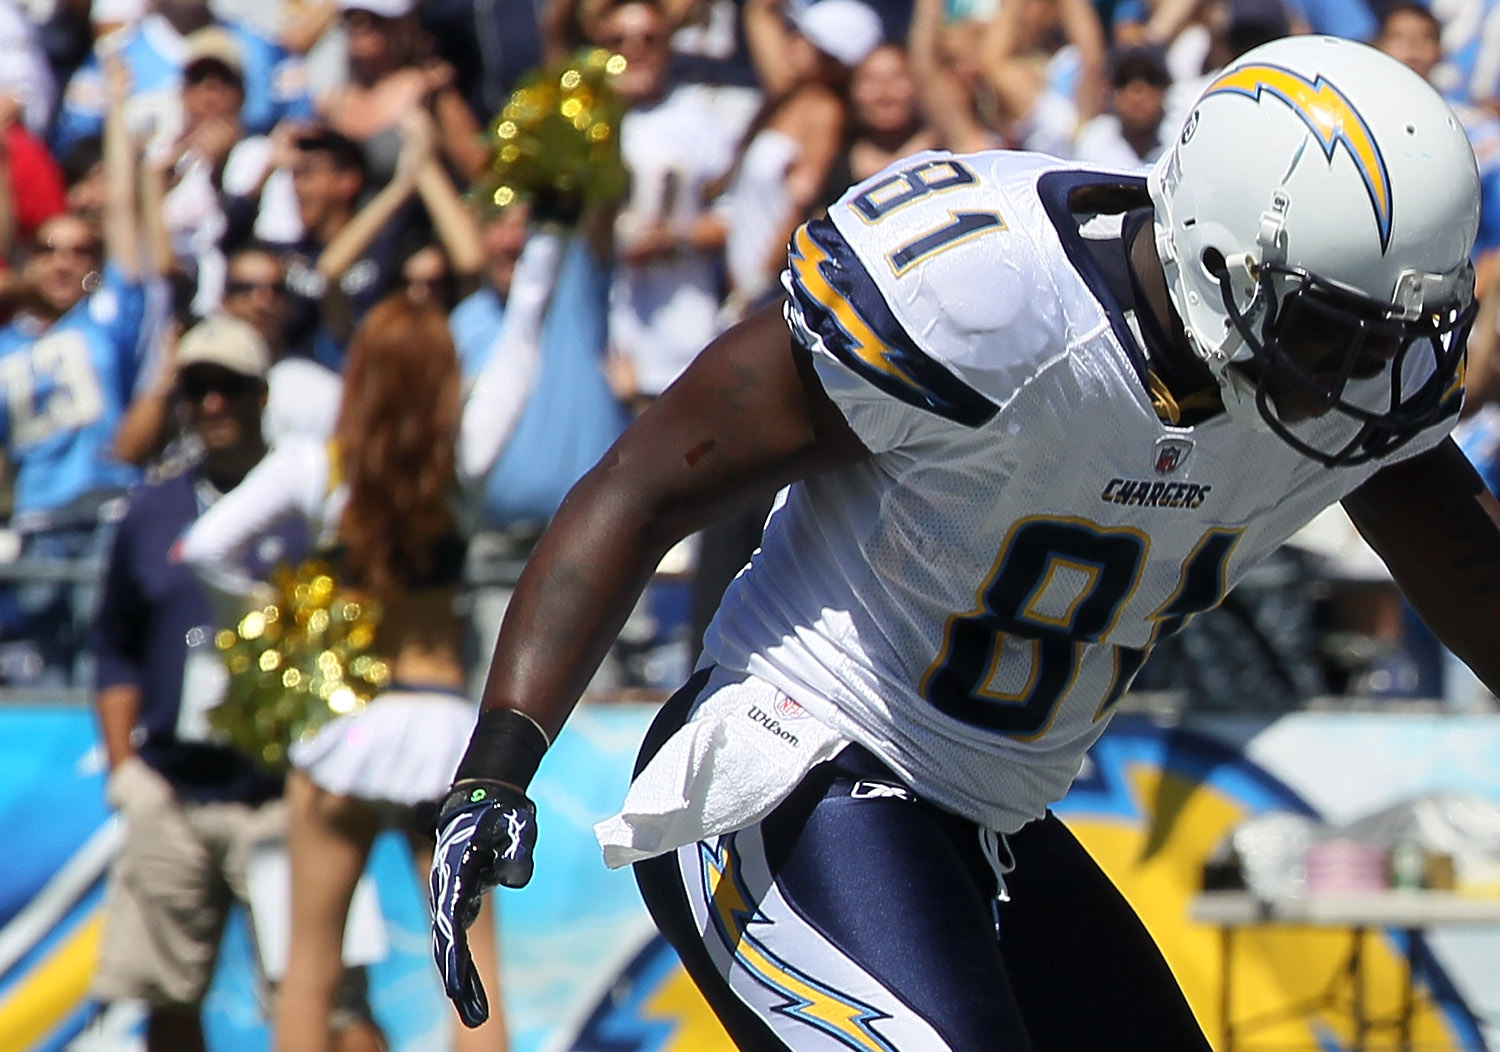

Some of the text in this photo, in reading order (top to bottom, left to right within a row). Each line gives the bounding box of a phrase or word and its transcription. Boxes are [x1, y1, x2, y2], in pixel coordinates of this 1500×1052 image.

[849, 160, 1008, 278] 81
[1101, 478, 1212, 509] CHARGERS
[919, 514, 1248, 742] 81
[747, 704, 801, 749] Wilson
